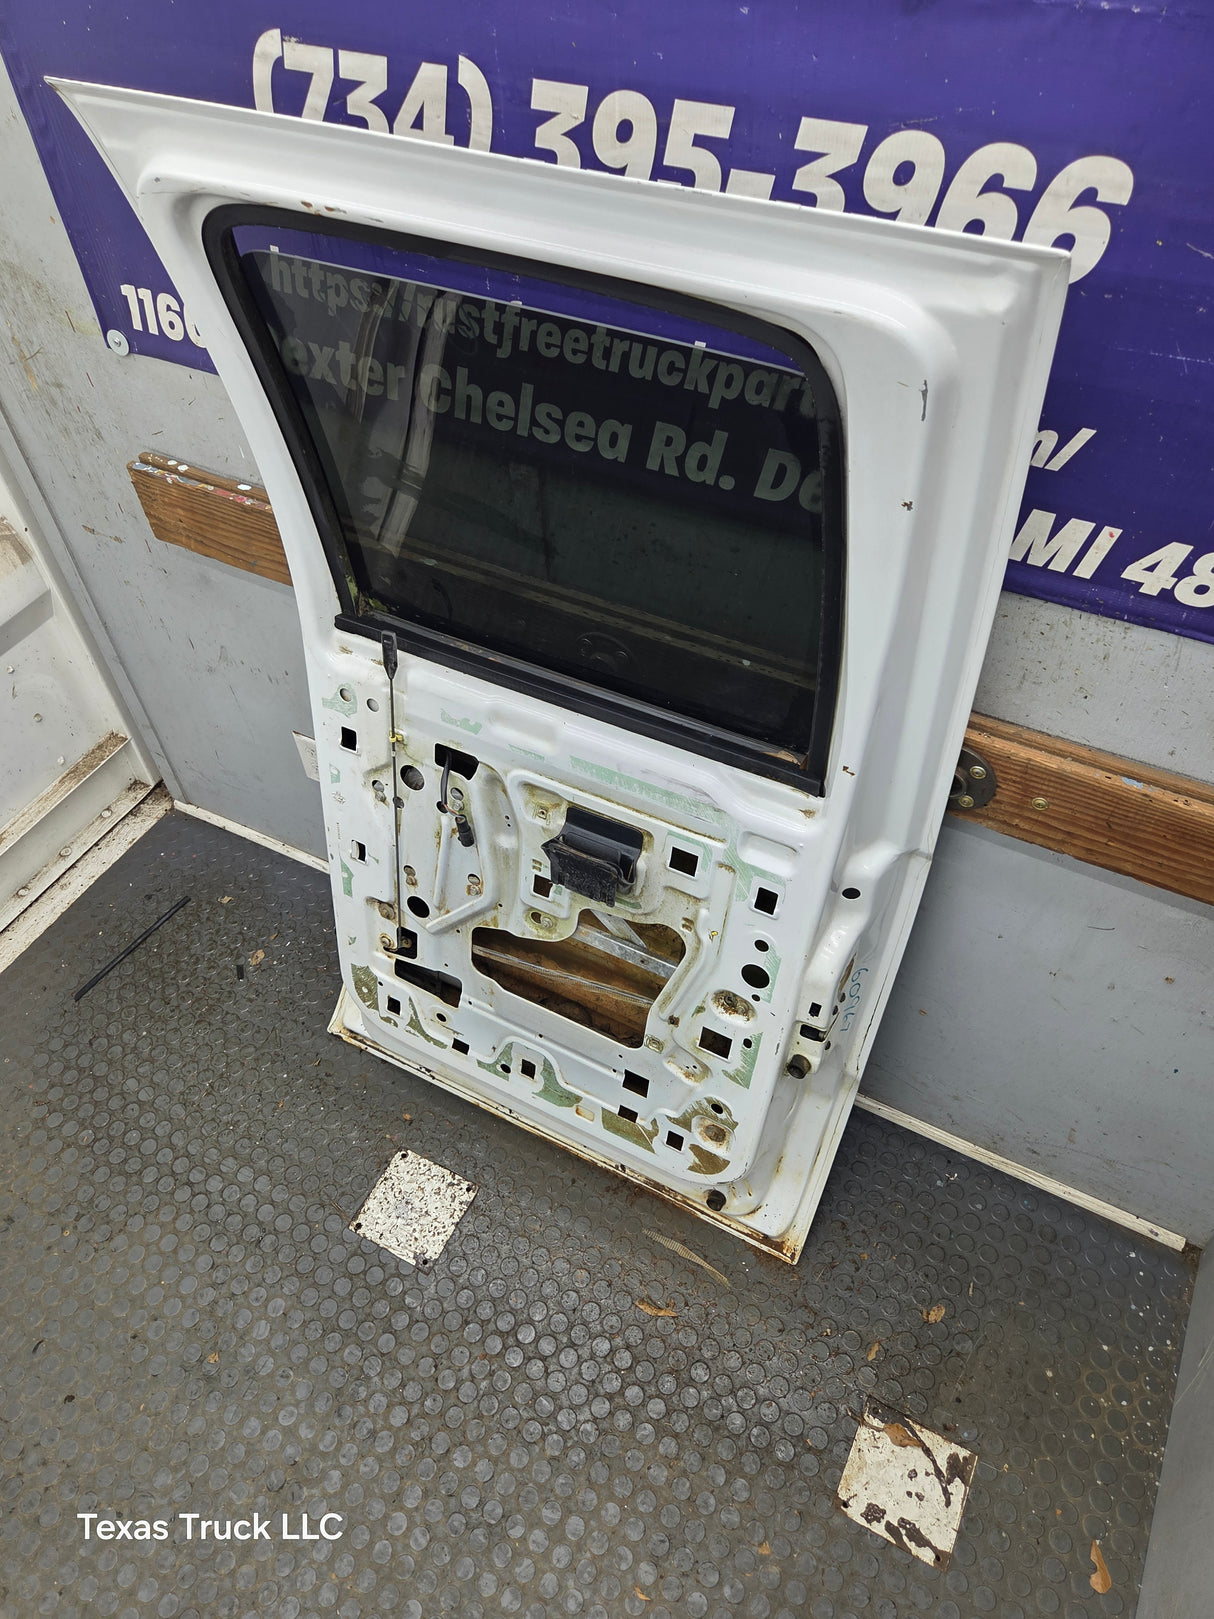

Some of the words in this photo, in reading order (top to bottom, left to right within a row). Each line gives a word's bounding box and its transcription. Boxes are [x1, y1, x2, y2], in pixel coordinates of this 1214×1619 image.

[252, 28, 494, 154] (734)
[530, 77, 1134, 285] 395-3966
[270, 323, 406, 402] exter
[419, 362, 634, 464] Chelsea
[645, 420, 736, 491] Rd.
[1007, 508, 1124, 580] MI
